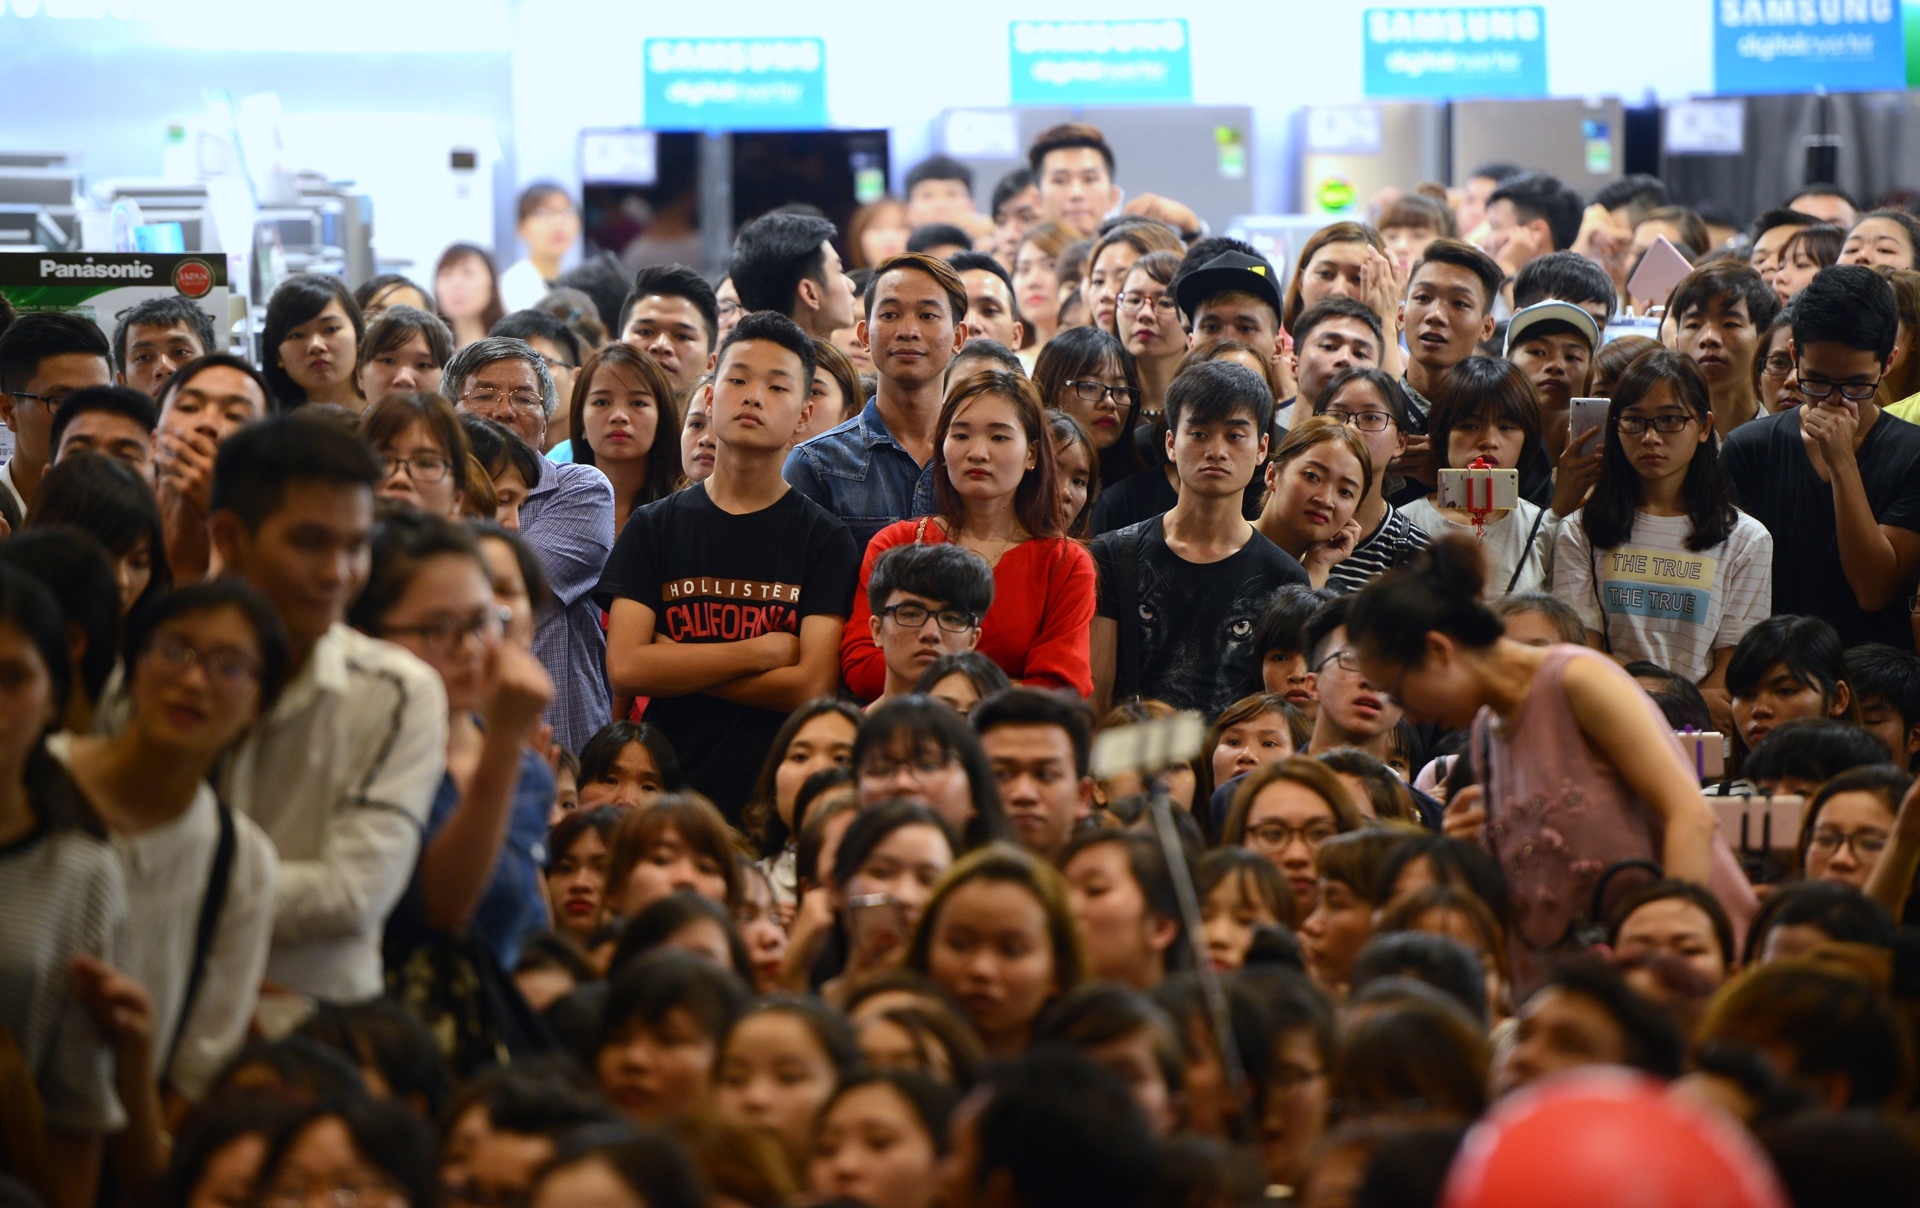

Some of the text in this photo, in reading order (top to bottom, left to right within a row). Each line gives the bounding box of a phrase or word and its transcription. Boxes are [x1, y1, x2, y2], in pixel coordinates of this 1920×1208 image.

[1369, 9, 1540, 44] SAMSUNG
[40, 256, 154, 279] Panasonic
[1613, 553, 1702, 580] THE TRUE
[669, 579, 800, 602] HOLLISTER
[1609, 587, 1696, 613] THE TRUE
